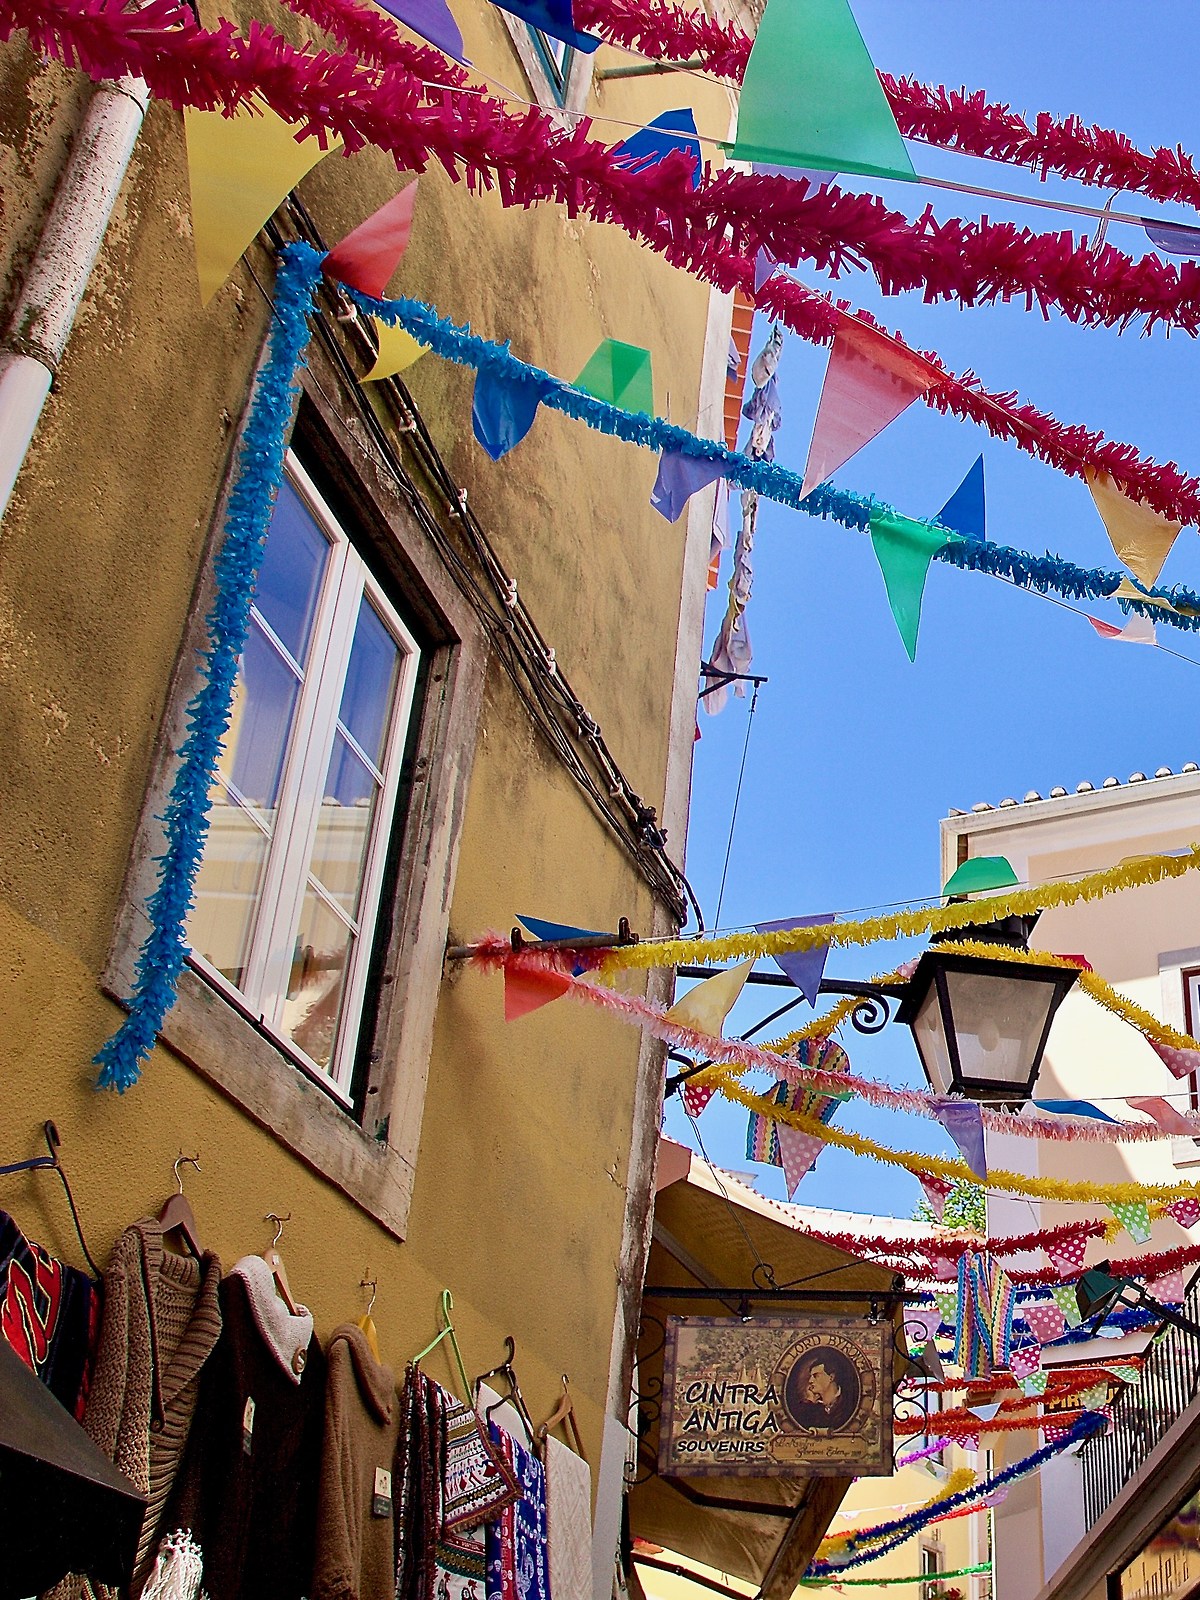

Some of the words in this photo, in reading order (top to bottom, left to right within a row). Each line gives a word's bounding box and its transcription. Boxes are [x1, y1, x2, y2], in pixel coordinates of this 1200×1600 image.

[788, 1335, 822, 1361] LORD
[685, 1381, 779, 1406] CINTRA
[682, 1409, 780, 1434] ANTIGA
[677, 1440, 765, 1453] SOUVENIRS
